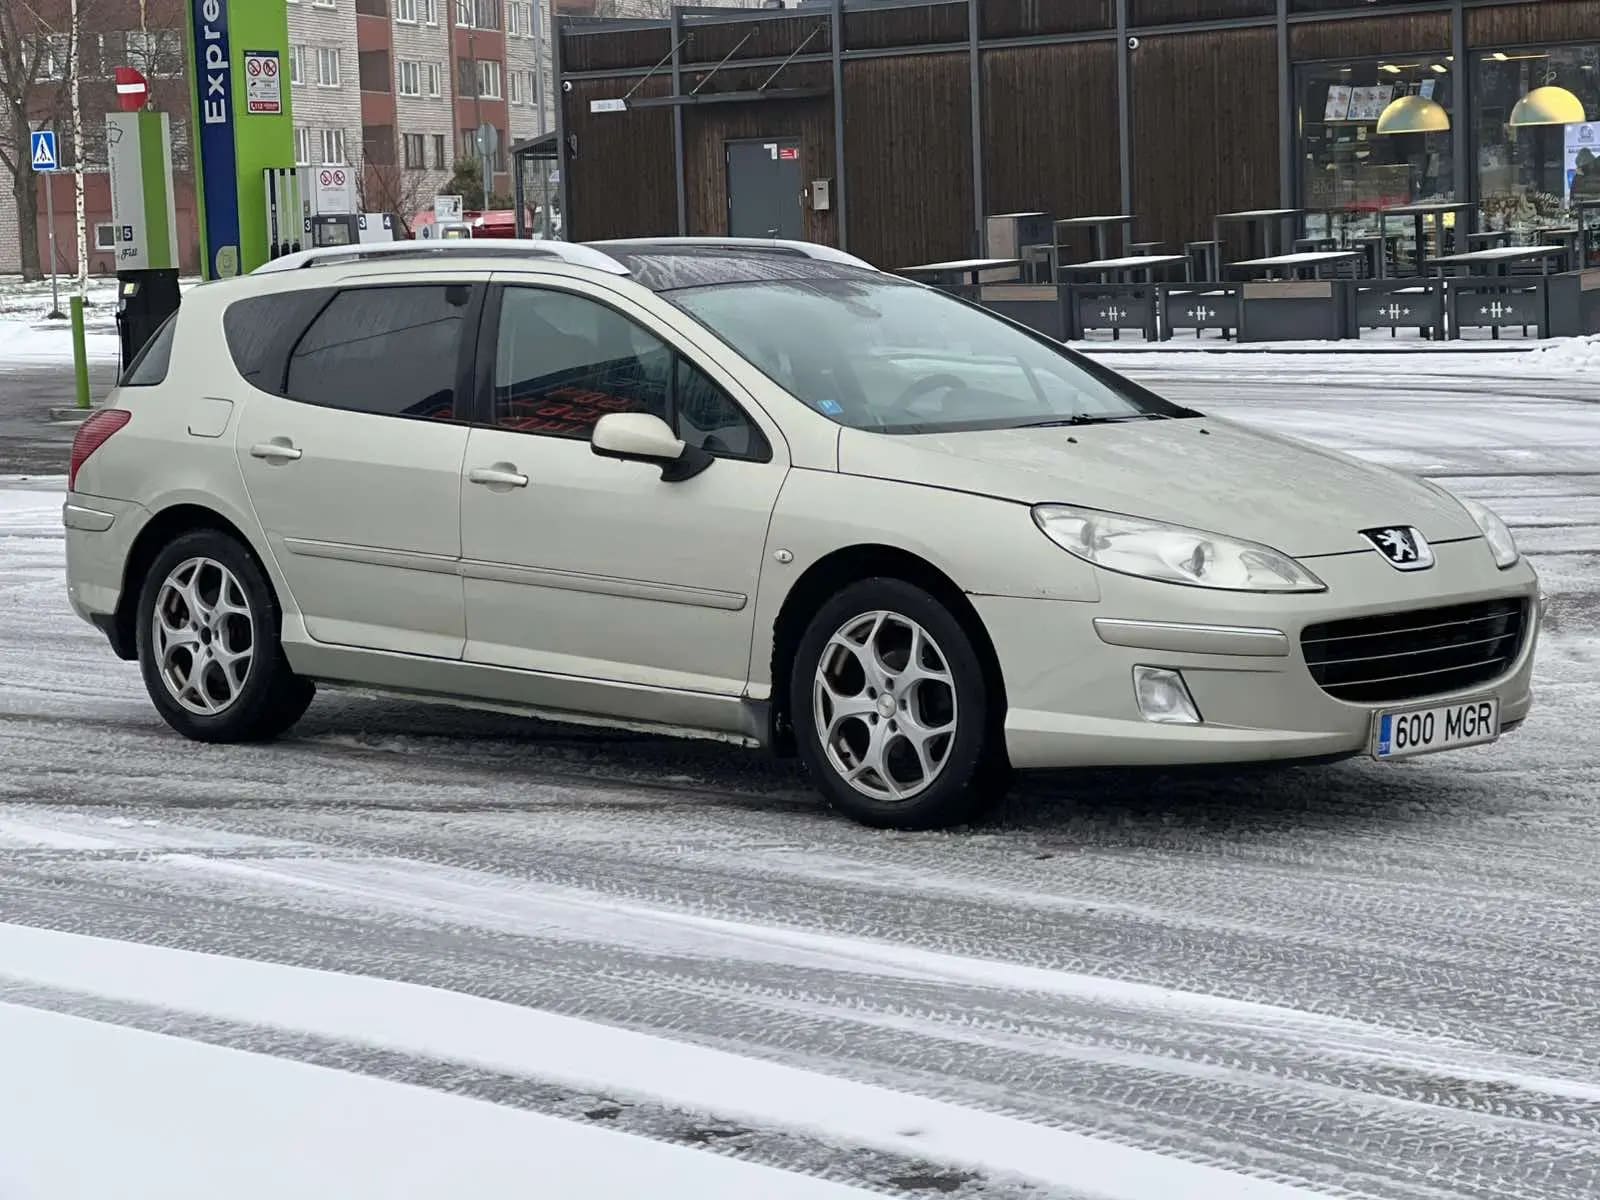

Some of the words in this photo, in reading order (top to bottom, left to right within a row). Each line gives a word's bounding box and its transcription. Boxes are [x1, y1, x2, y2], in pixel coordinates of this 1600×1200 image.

[203, 0, 229, 124] Expre
[304, 220, 311, 231] 3
[359, 216, 366, 228] 3
[384, 216, 391, 227] 4
[124, 228, 131, 239] 5
[1396, 712, 1434, 749] 600
[1445, 702, 1492, 741] MGR
